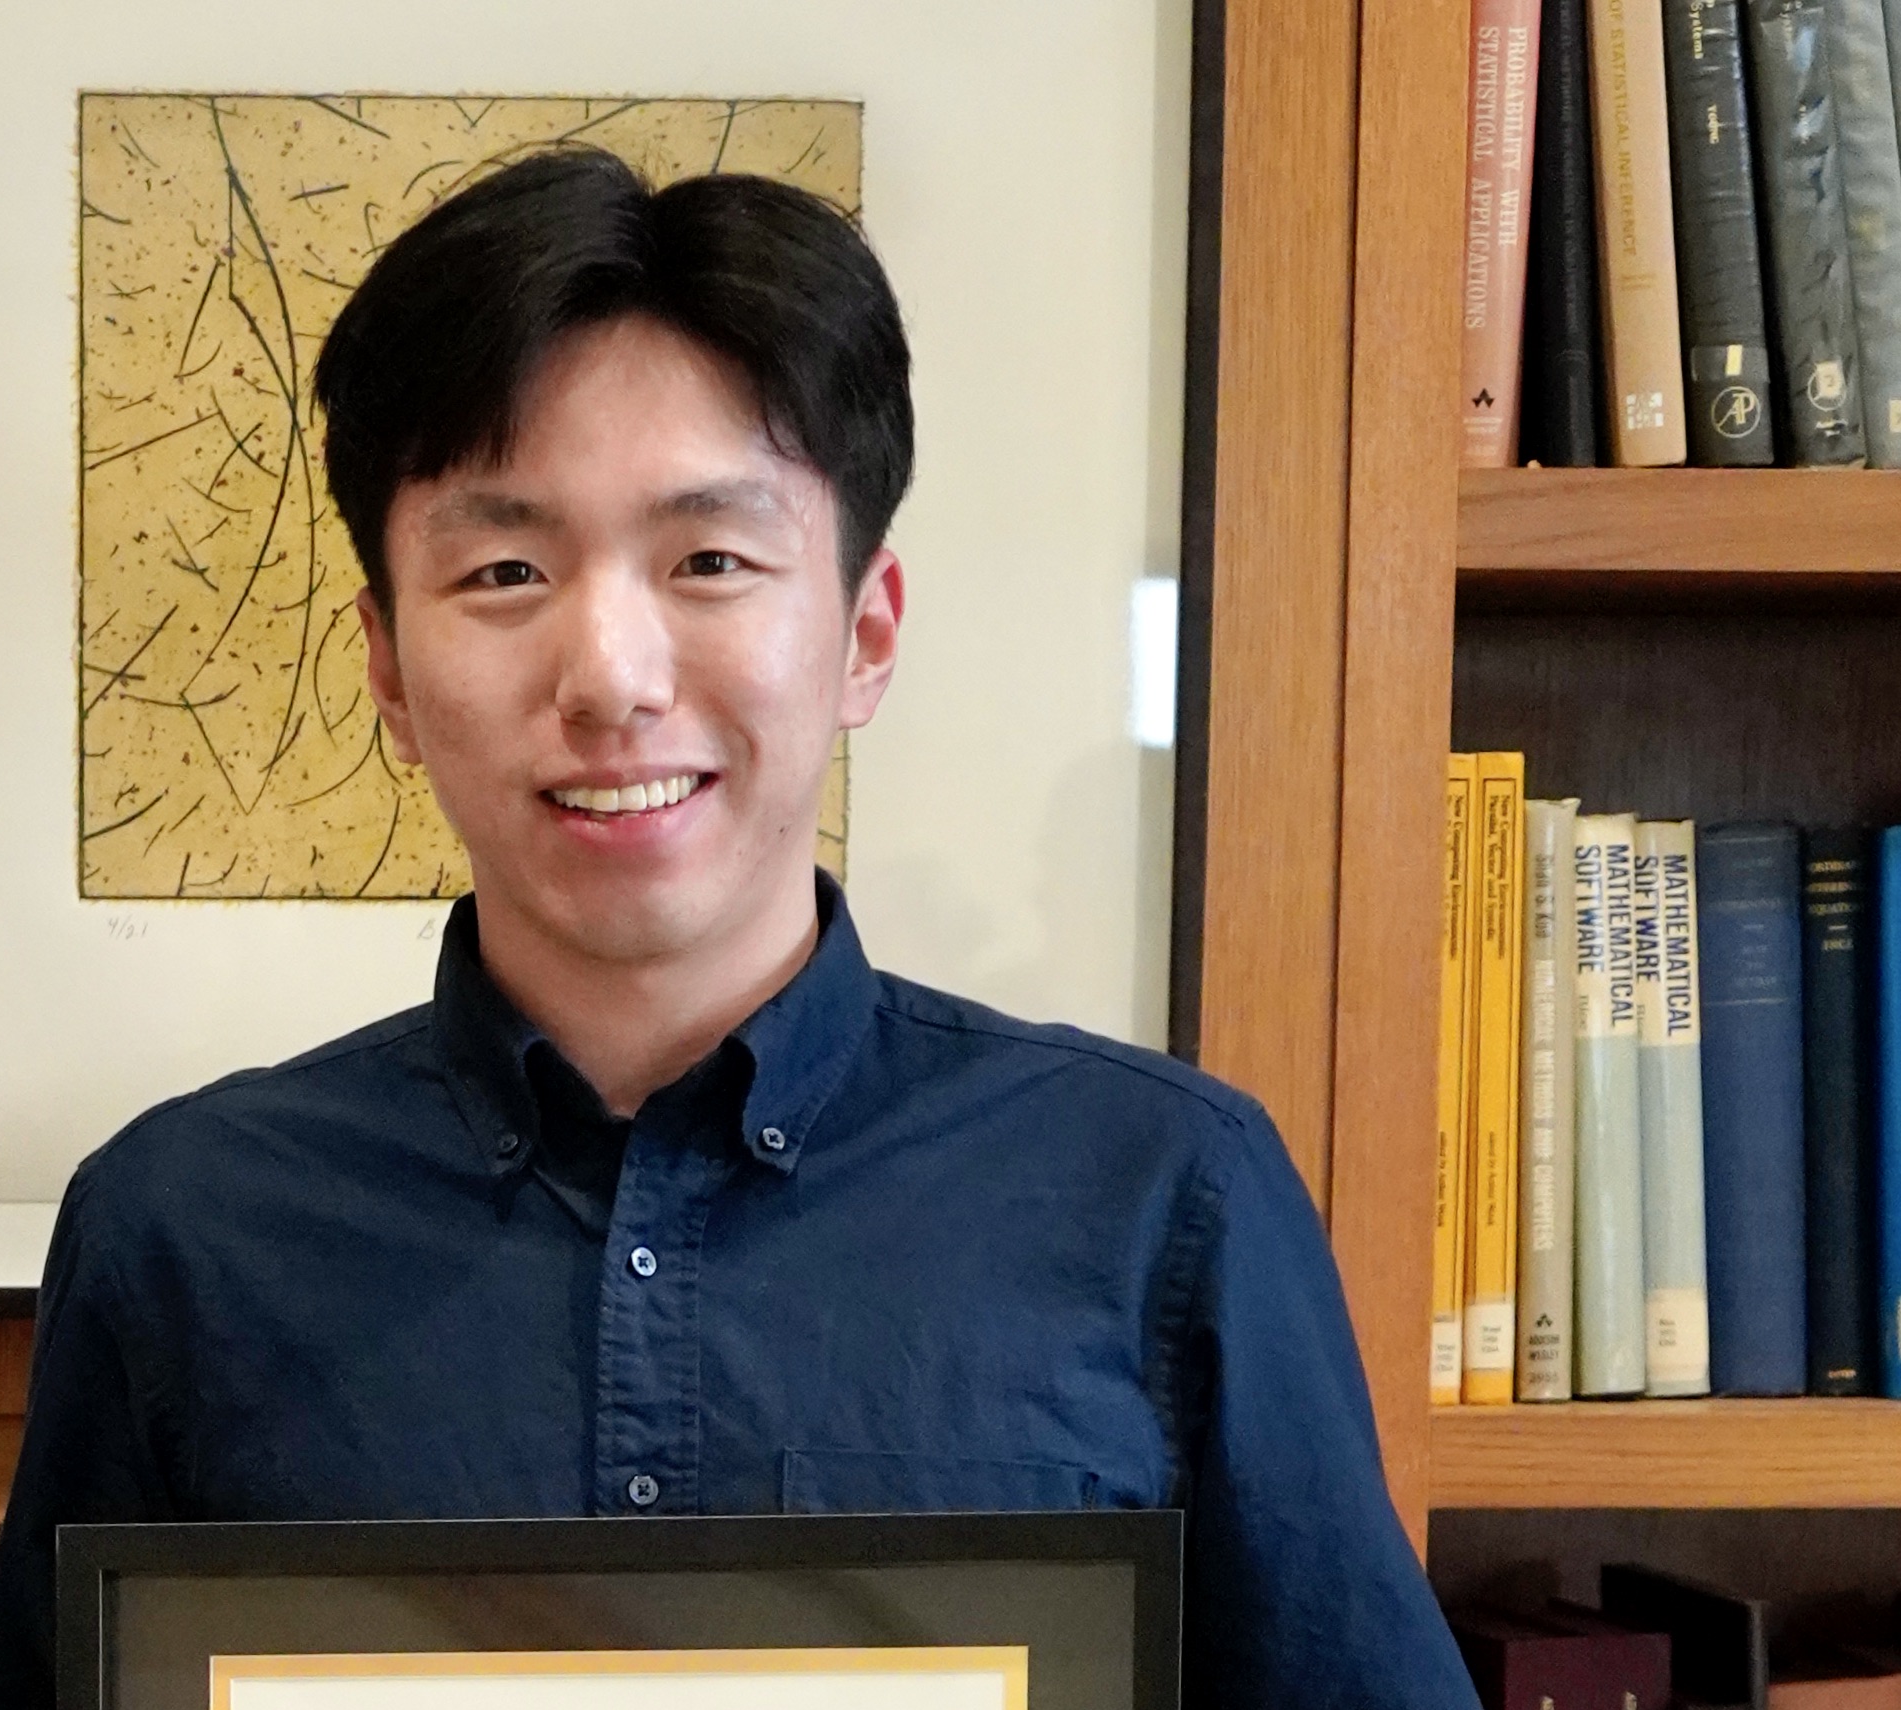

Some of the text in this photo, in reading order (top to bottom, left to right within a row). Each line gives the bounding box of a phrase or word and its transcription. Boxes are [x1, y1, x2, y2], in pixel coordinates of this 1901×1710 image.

[1497, 26, 1527, 247] PROBABILITY WITH
[1612, 28, 1633, 144] STATISTICAL
[1465, 26, 1499, 328] STATISTICAL APPLICATIONS
[1616, 151, 1639, 257] INFERENCE
[1575, 844, 1604, 974] SOFTWARE
[1608, 844, 1635, 1027] MATHEMATICAL
[1635, 855, 1660, 983] SOFTWARE
[1664, 854, 1692, 1036] MATHEMATICAL
